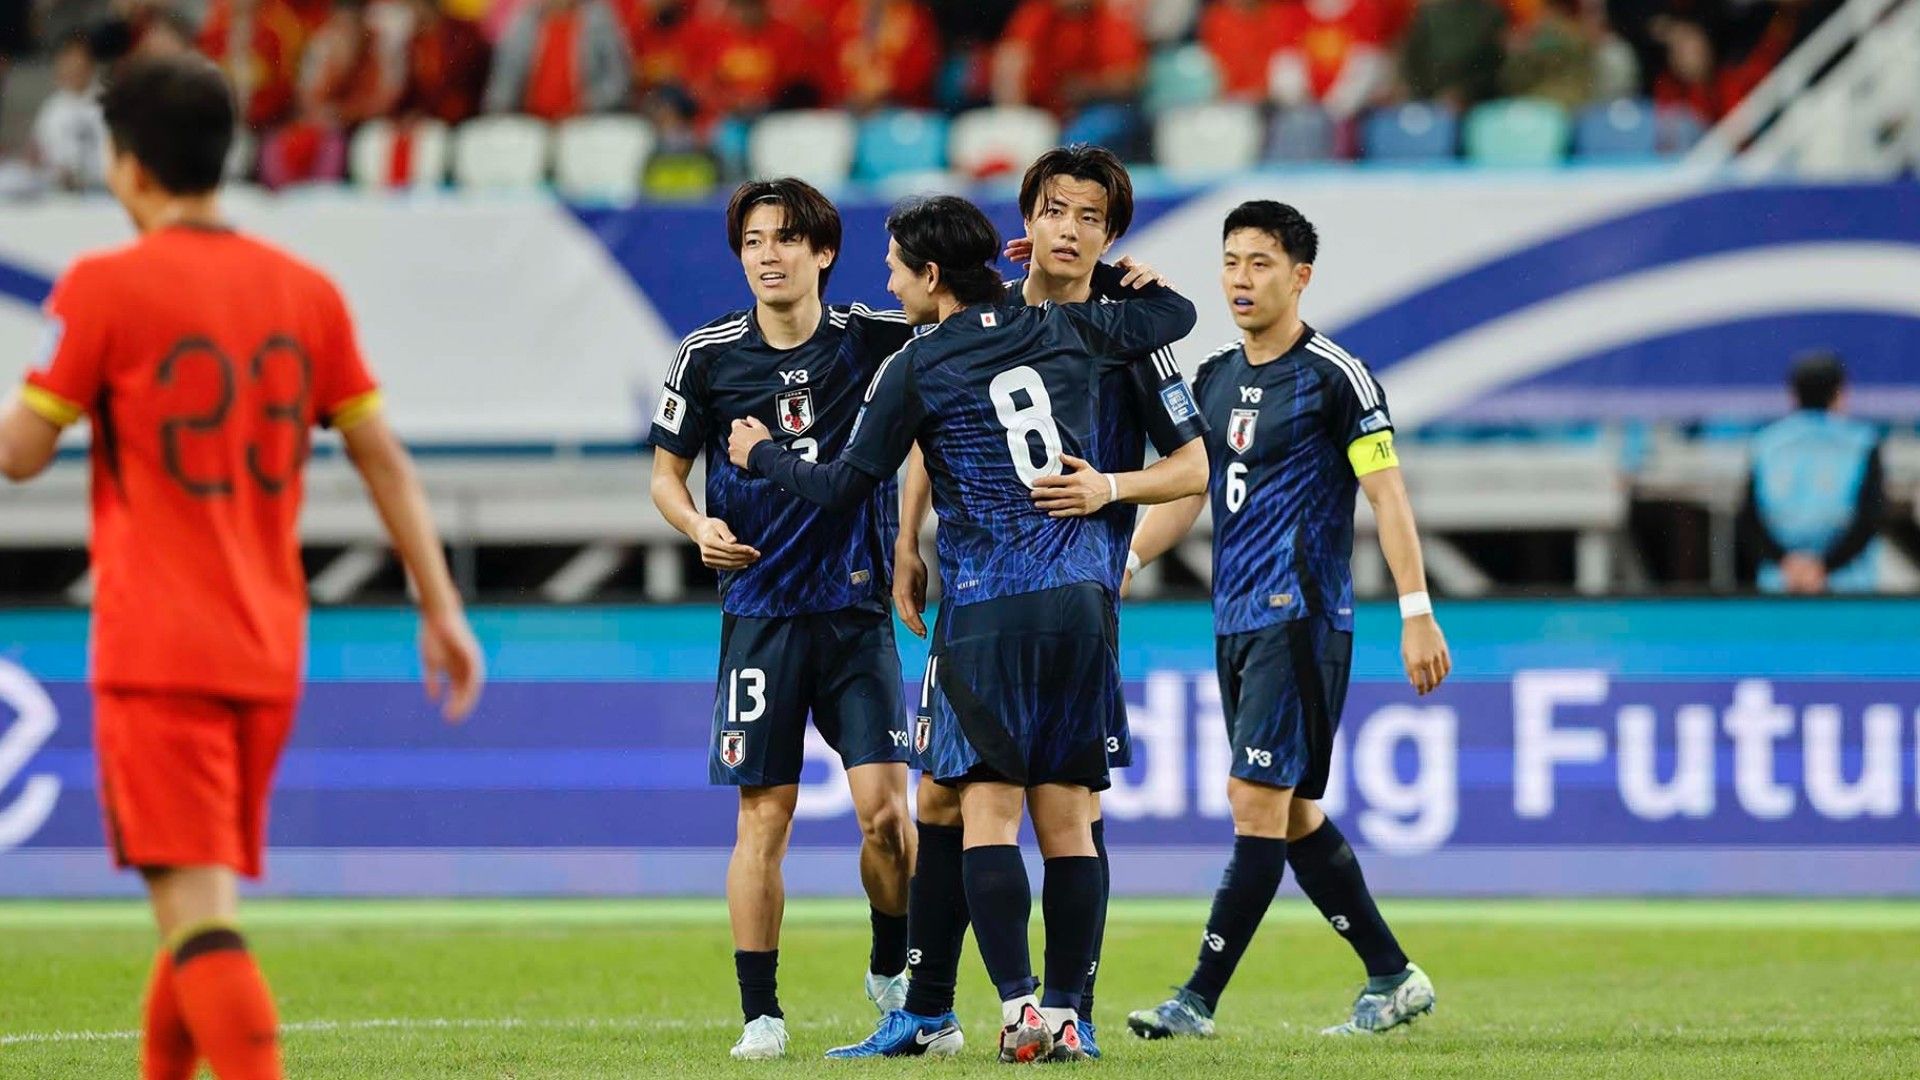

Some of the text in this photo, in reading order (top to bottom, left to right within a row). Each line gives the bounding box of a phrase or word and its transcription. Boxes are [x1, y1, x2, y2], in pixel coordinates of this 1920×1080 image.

[778, 369, 809, 386] Y-3
[1239, 385, 1263, 403] Y-3
[157, 331, 314, 497] 23
[989, 366, 1063, 489] 8
[1226, 462, 1249, 514] 6
[728, 668, 767, 722] 13
[888, 730, 909, 747] Y-3
[1246, 747, 1272, 767] Y-3
